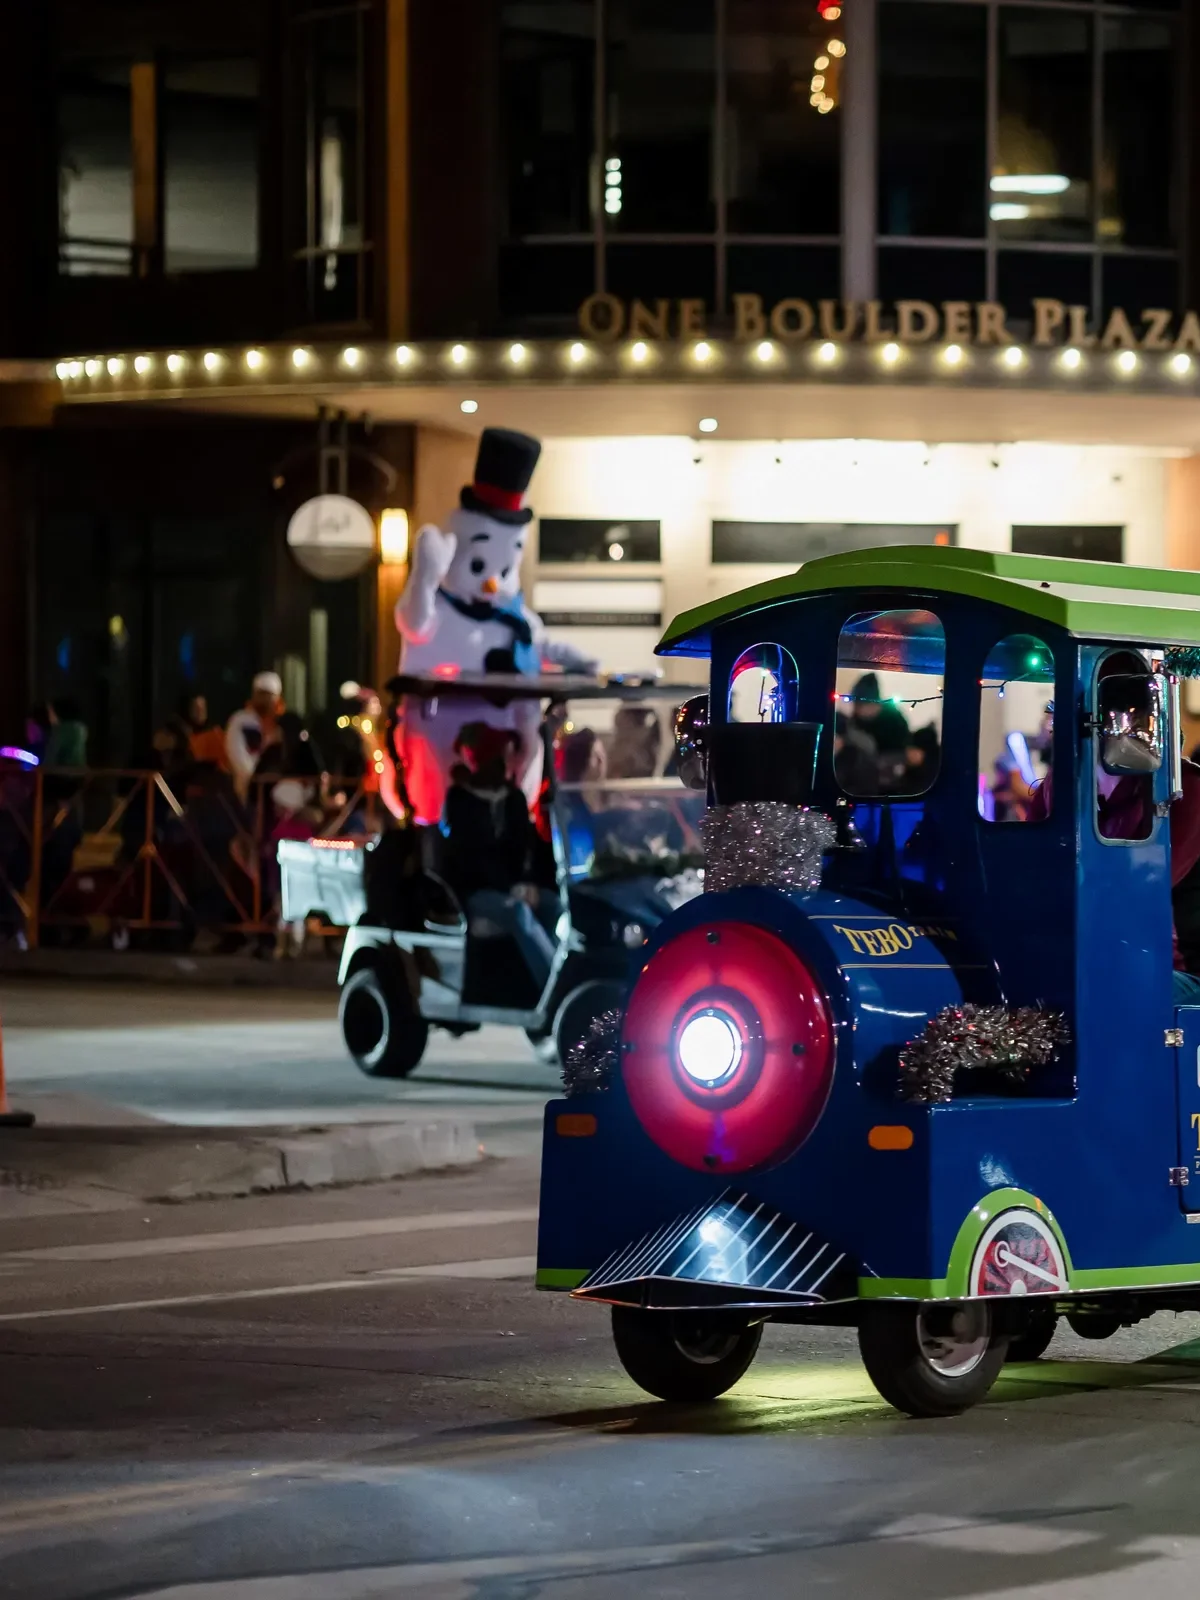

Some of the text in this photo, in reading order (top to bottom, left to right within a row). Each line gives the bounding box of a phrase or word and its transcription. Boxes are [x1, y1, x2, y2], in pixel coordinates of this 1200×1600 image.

[578, 291, 708, 341] ONE
[732, 290, 1015, 343] BOULDER
[832, 923, 913, 956] TEBO
